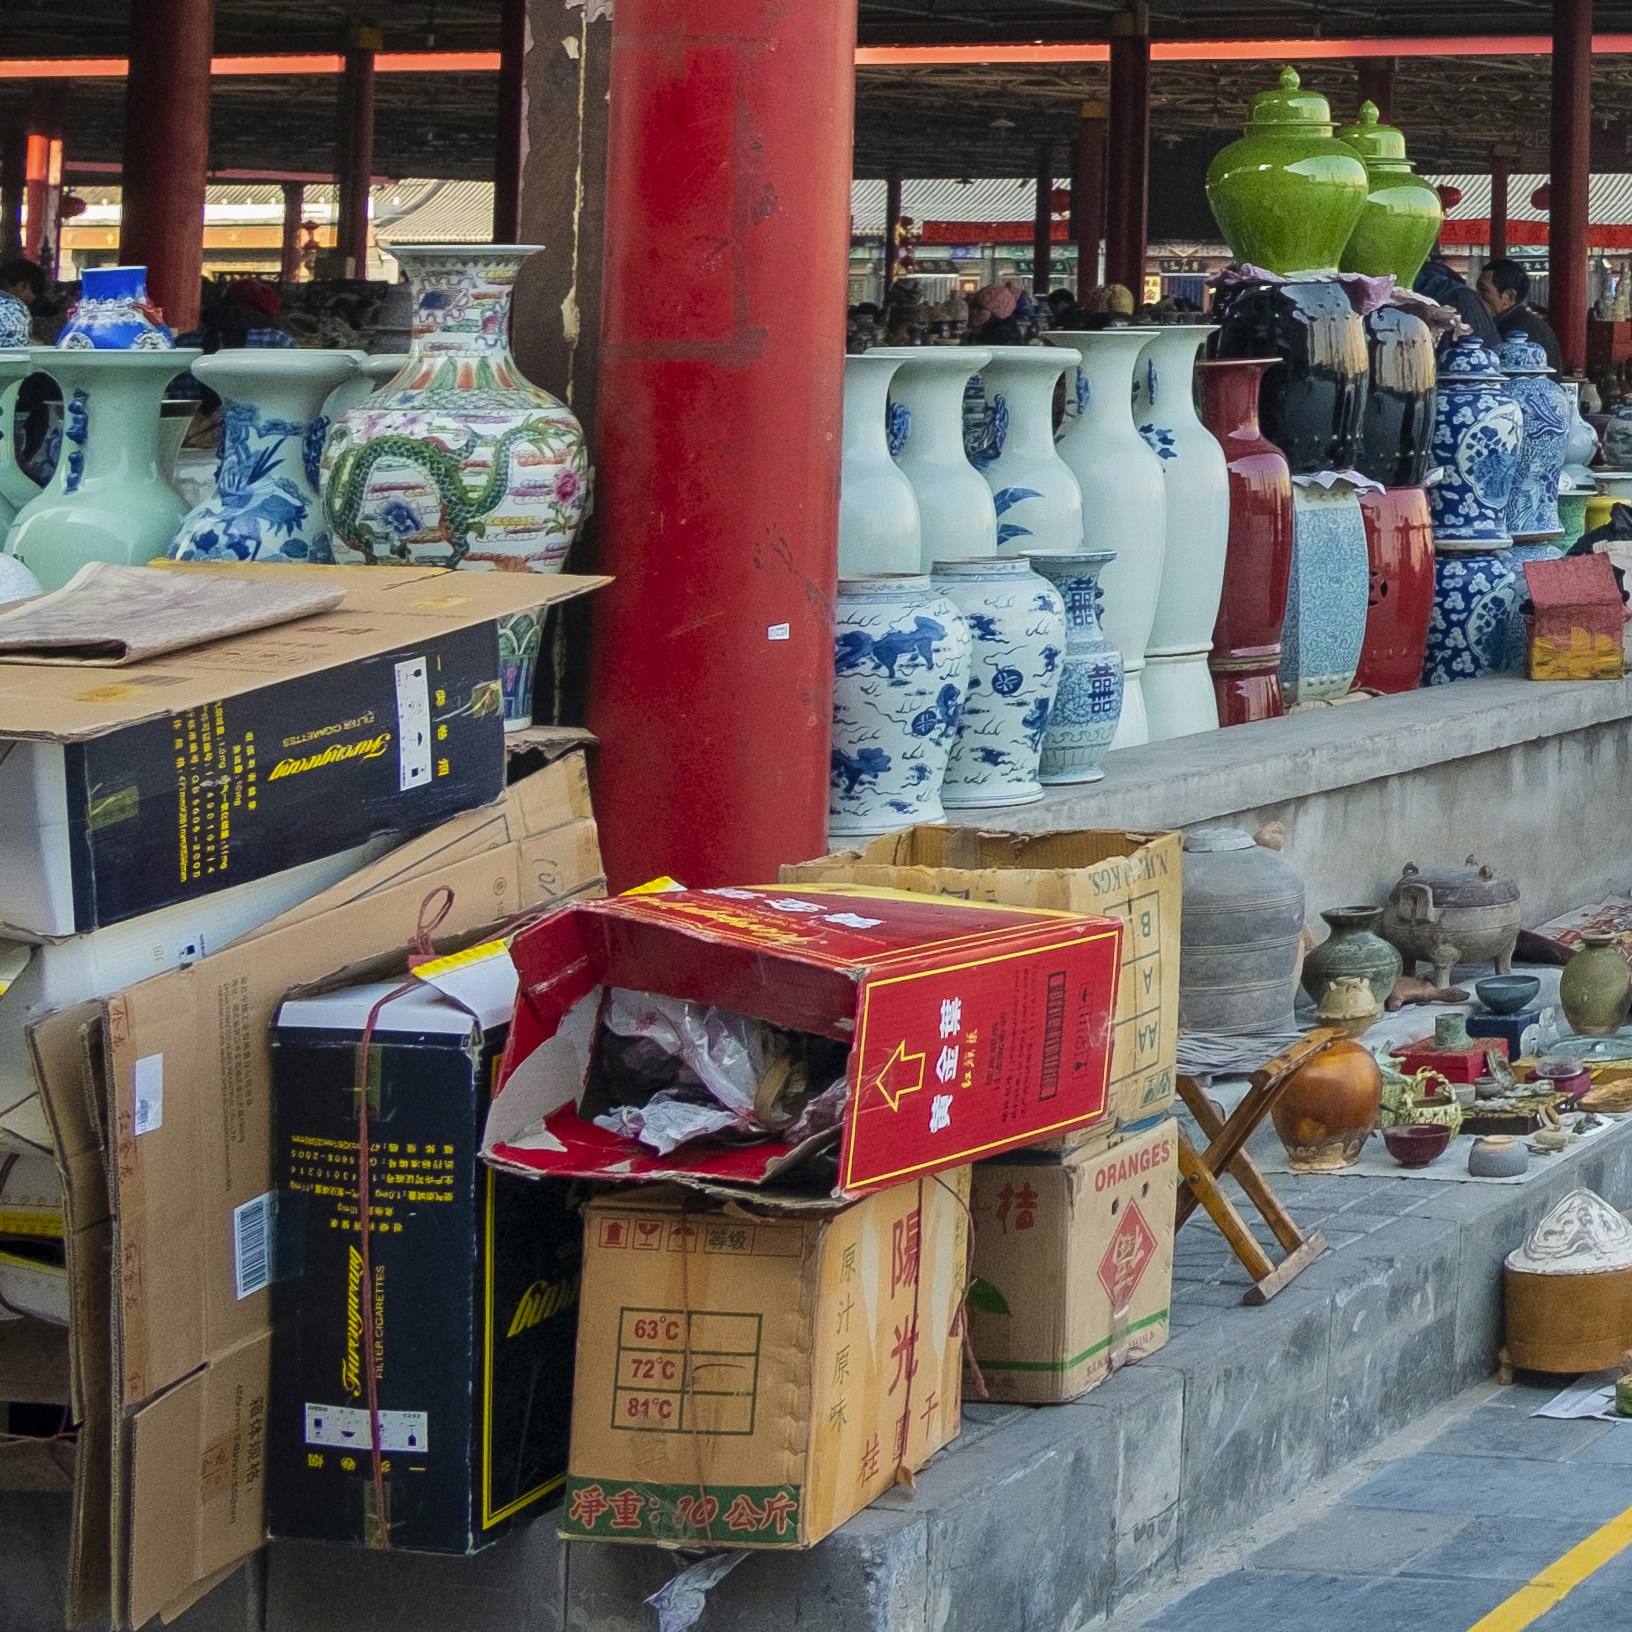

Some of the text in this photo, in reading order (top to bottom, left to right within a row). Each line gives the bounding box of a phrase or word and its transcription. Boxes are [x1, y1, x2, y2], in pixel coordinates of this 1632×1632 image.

[1140, 911, 1152, 937] B
[1141, 966, 1154, 991] A
[1137, 1020, 1158, 1054] AA
[1093, 1138, 1171, 1193] ORANGES
[829, 1242, 858, 1433] 原汁原味
